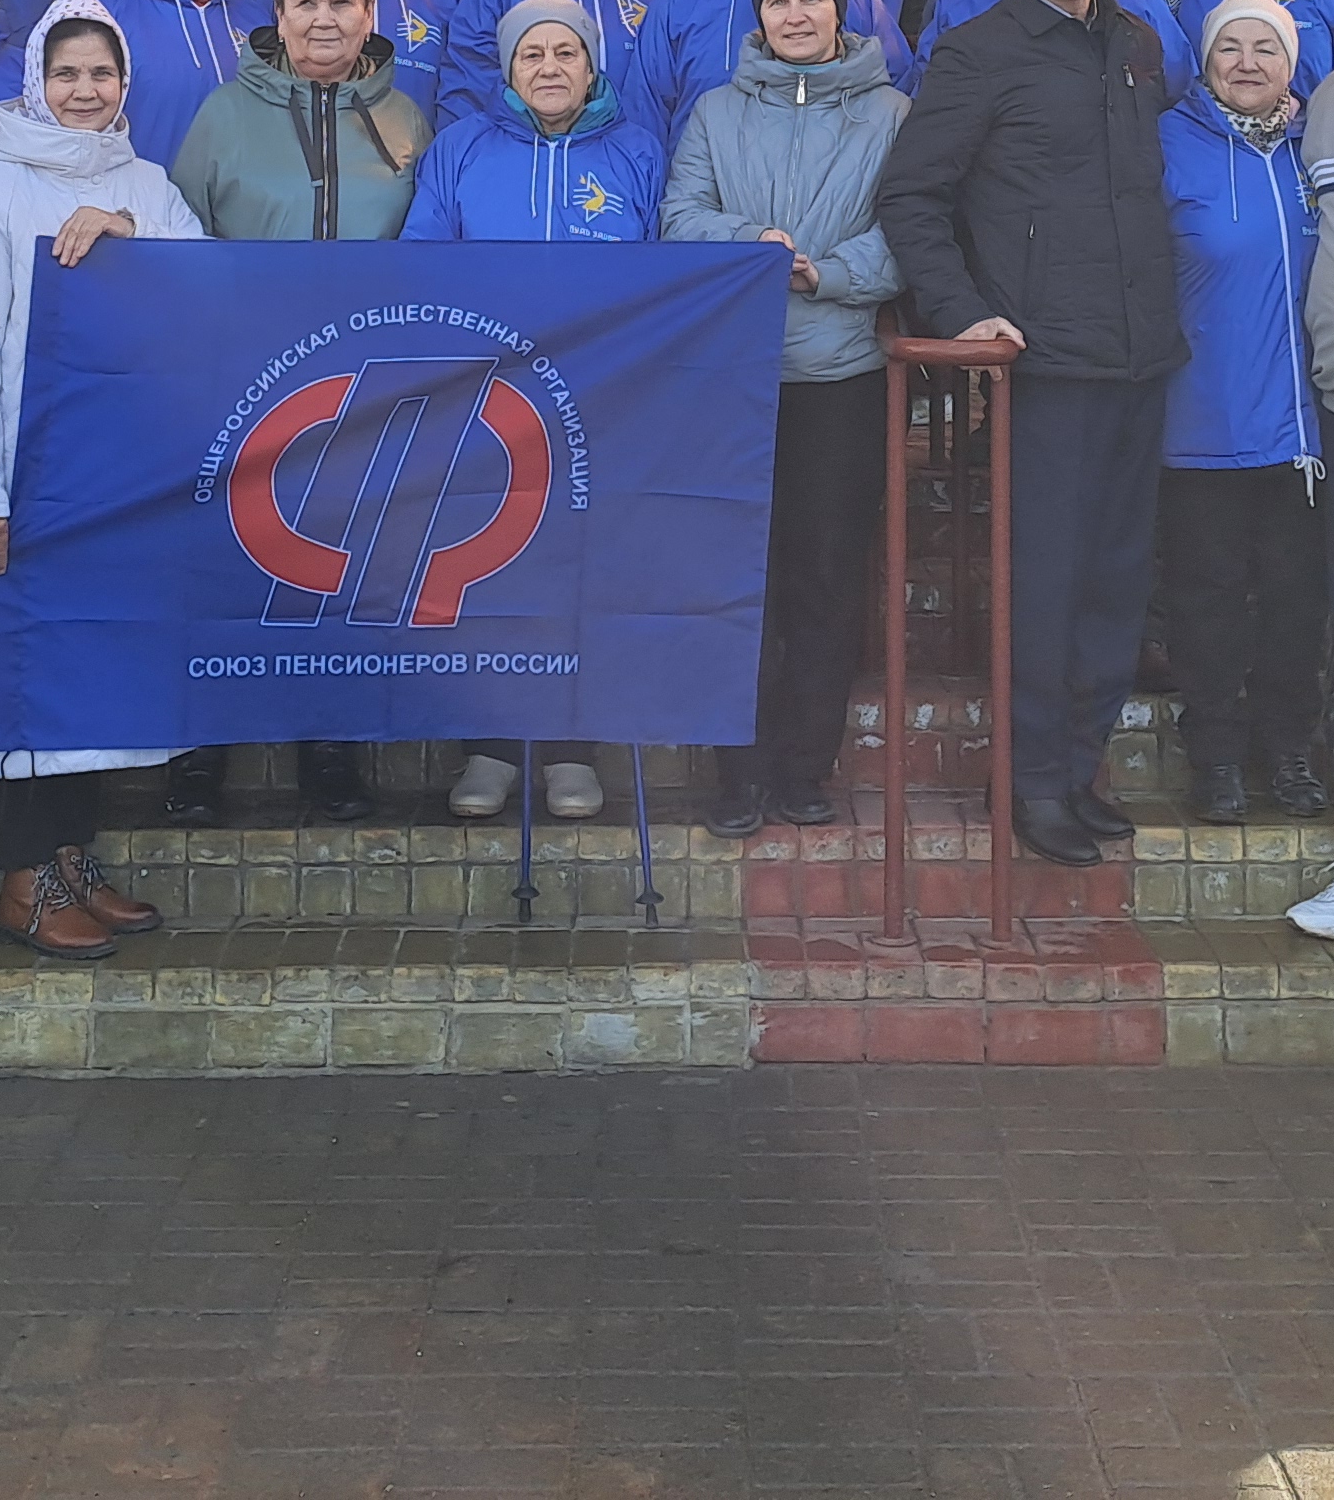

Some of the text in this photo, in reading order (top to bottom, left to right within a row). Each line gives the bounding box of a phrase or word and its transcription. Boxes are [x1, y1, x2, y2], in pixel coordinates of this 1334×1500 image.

[193, 304, 591, 511] ОБЩЕРОССИЙСКАЯ ОБЩЕСТВЕННАЯ ОРГАНИЗАЦИЯ
[187, 653, 580, 678] СОЮЗ ПЕНСИОНЕРОВ РОССИИ
